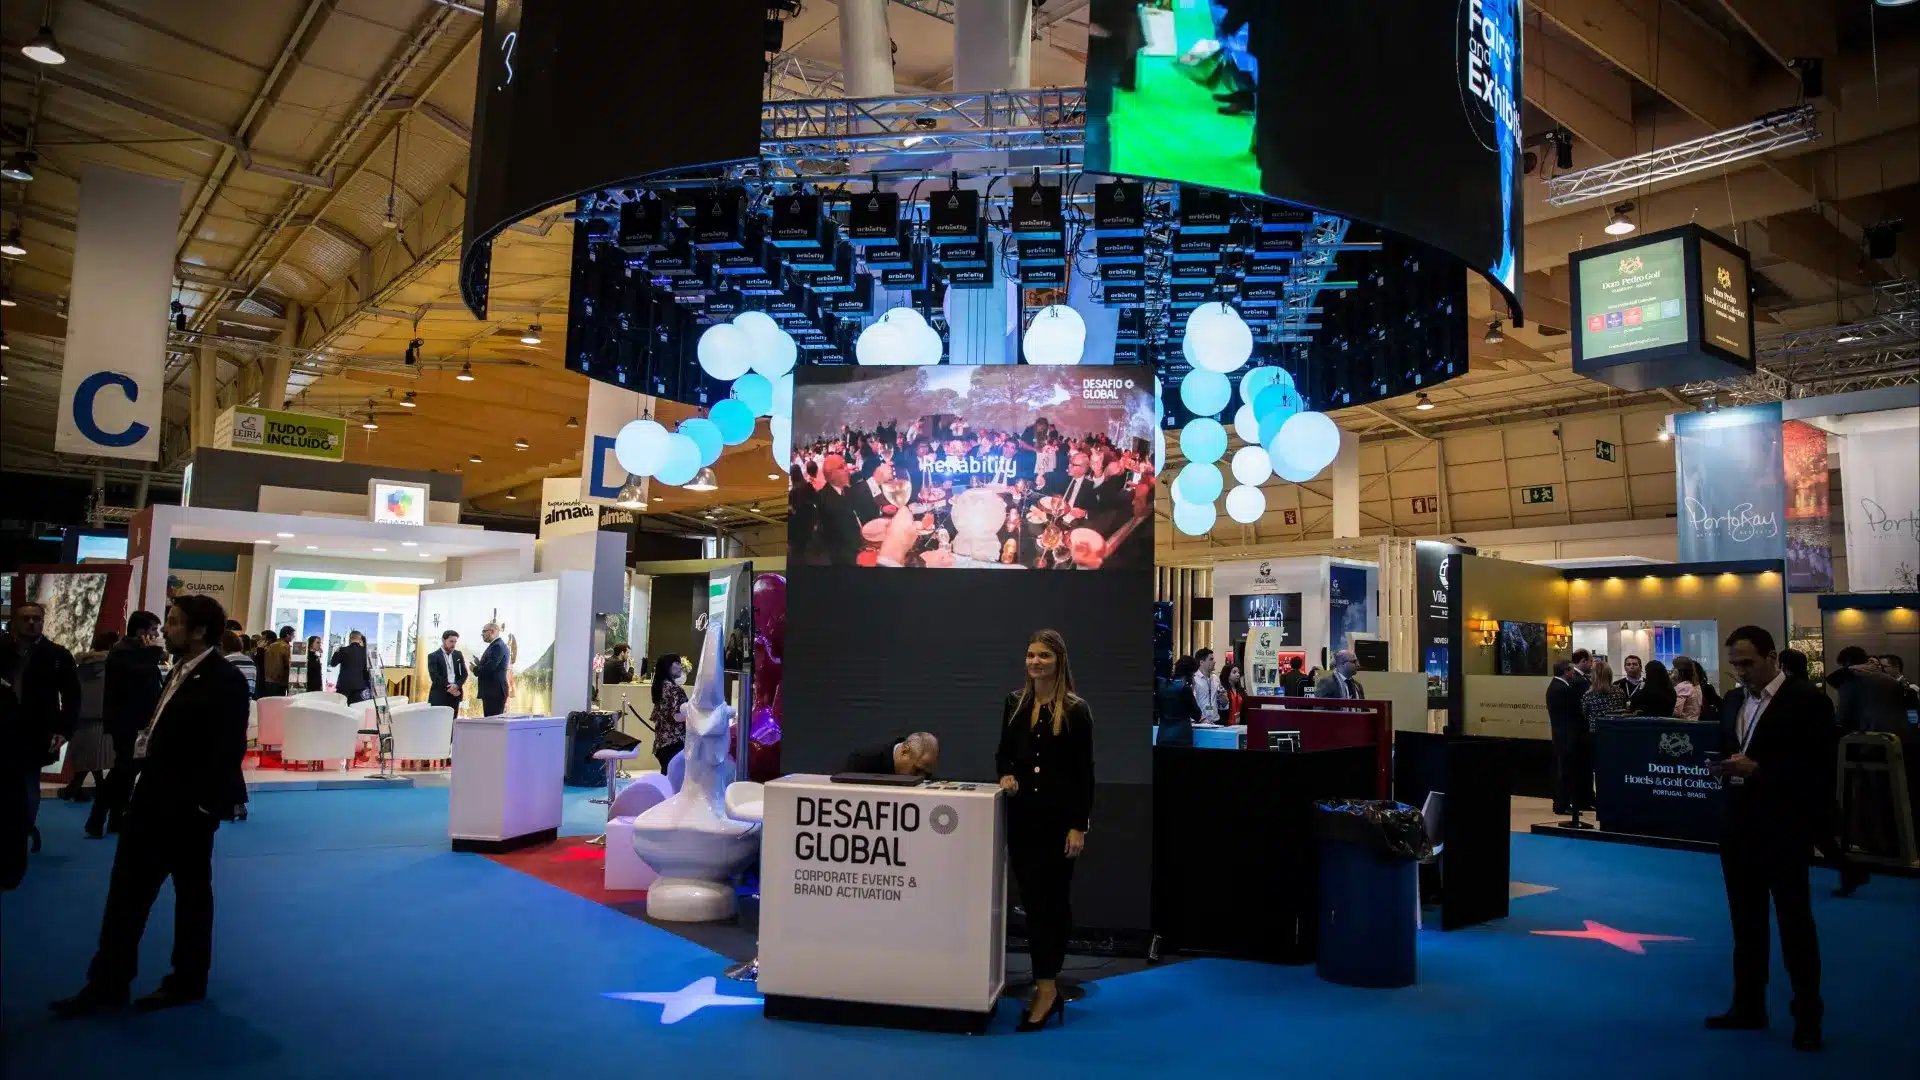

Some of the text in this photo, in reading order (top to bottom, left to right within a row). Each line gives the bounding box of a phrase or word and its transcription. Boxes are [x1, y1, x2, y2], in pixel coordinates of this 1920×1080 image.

[1469, 36, 1491, 67] and
[1083, 379, 1123, 389] DESAFIO
[1083, 389, 1119, 399] GLOBAL
[73, 370, 150, 447] C
[233, 428, 262, 440] LEIRIA
[267, 421, 307, 436] TUDO
[919, 455, 1017, 478] Reliability
[544, 504, 594, 525] almada
[186, 582, 225, 591] GUARDA
[1432, 589, 1447, 603] Vila
[1648, 763, 1710, 776] Dom Pedro
[1624, 774, 1654, 785] Hotels
[1662, 777, 1682, 787] Golf
[1652, 788, 1682, 797] PORTUGAL
[1687, 791, 1707, 799] BRASIL
[796, 796, 920, 832] DESAFIO
[795, 831, 906, 867] GLOBAL
[794, 869, 917, 888] CORPORATE EVENTS &
[794, 883, 901, 901] BRAND ACTIVATION
